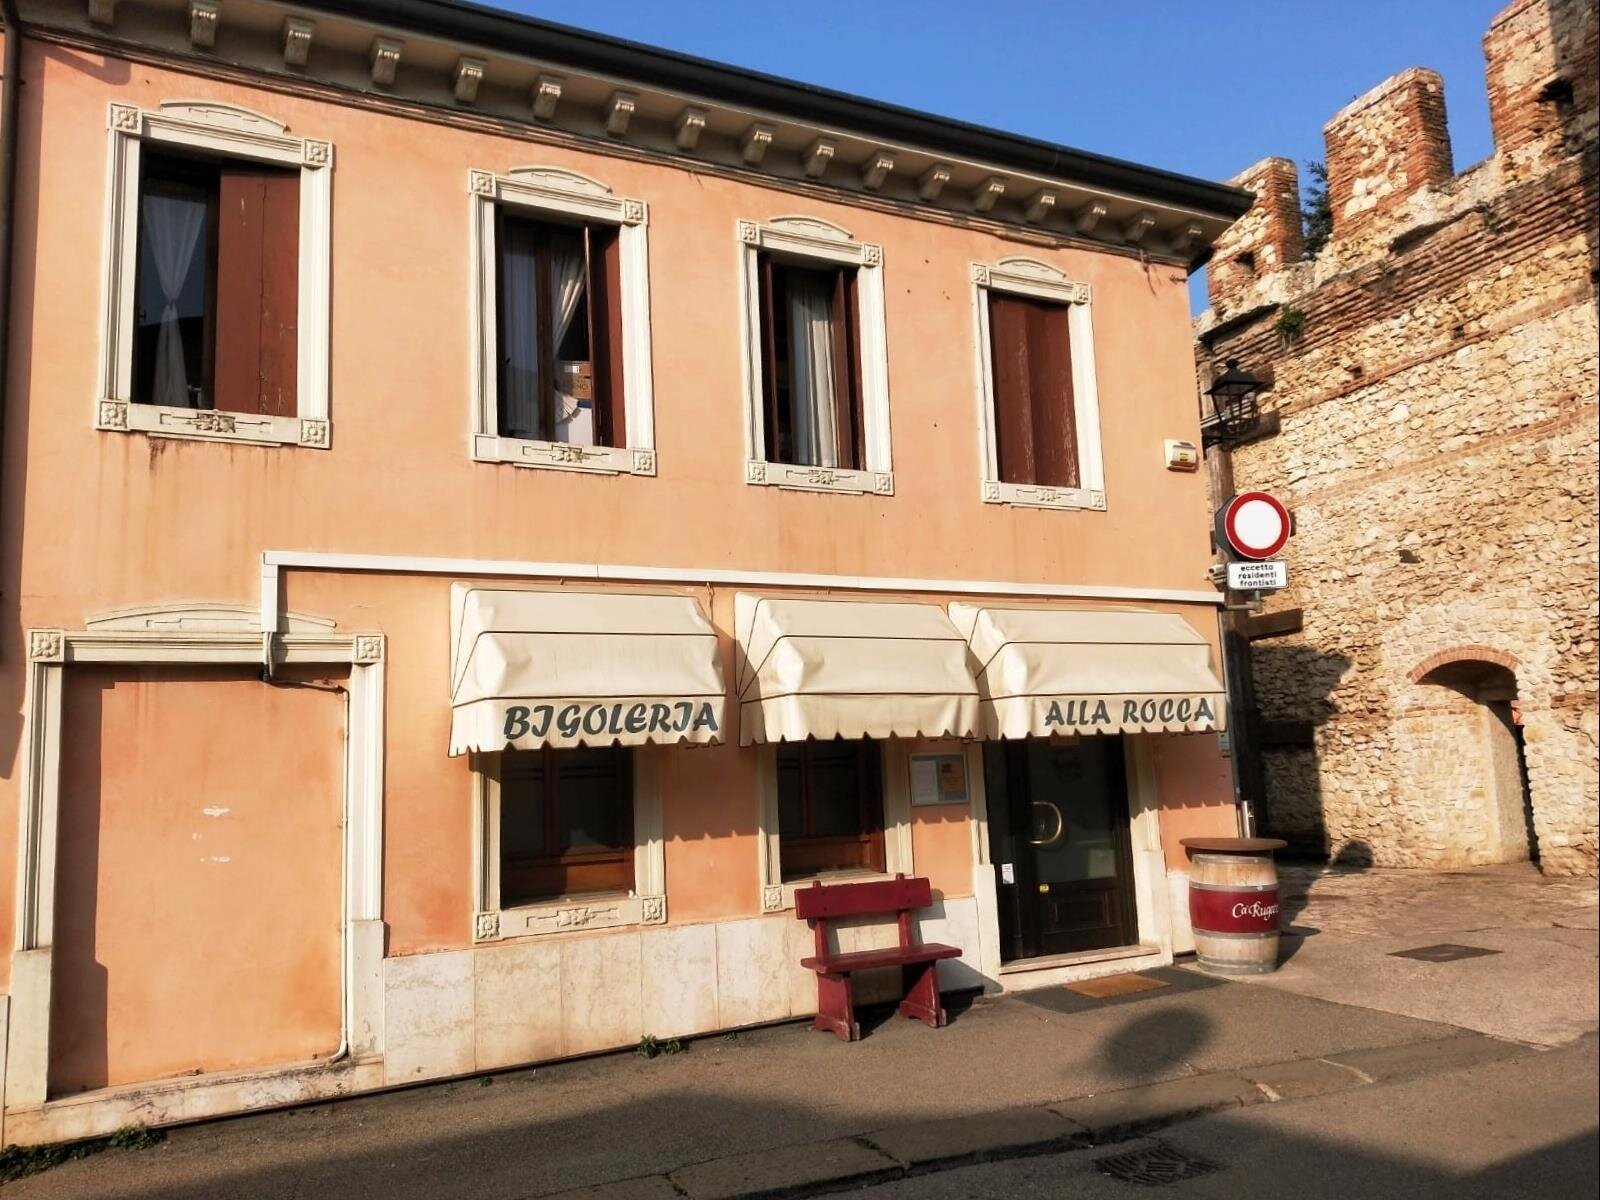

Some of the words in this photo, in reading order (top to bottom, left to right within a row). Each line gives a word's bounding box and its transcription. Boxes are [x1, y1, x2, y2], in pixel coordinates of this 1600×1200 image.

[1240, 564, 1274, 572] eccetto
[503, 702, 719, 740] BIGOLERIA
[1045, 699, 1111, 726] ALLA
[1123, 697, 1215, 724] ROCCA
